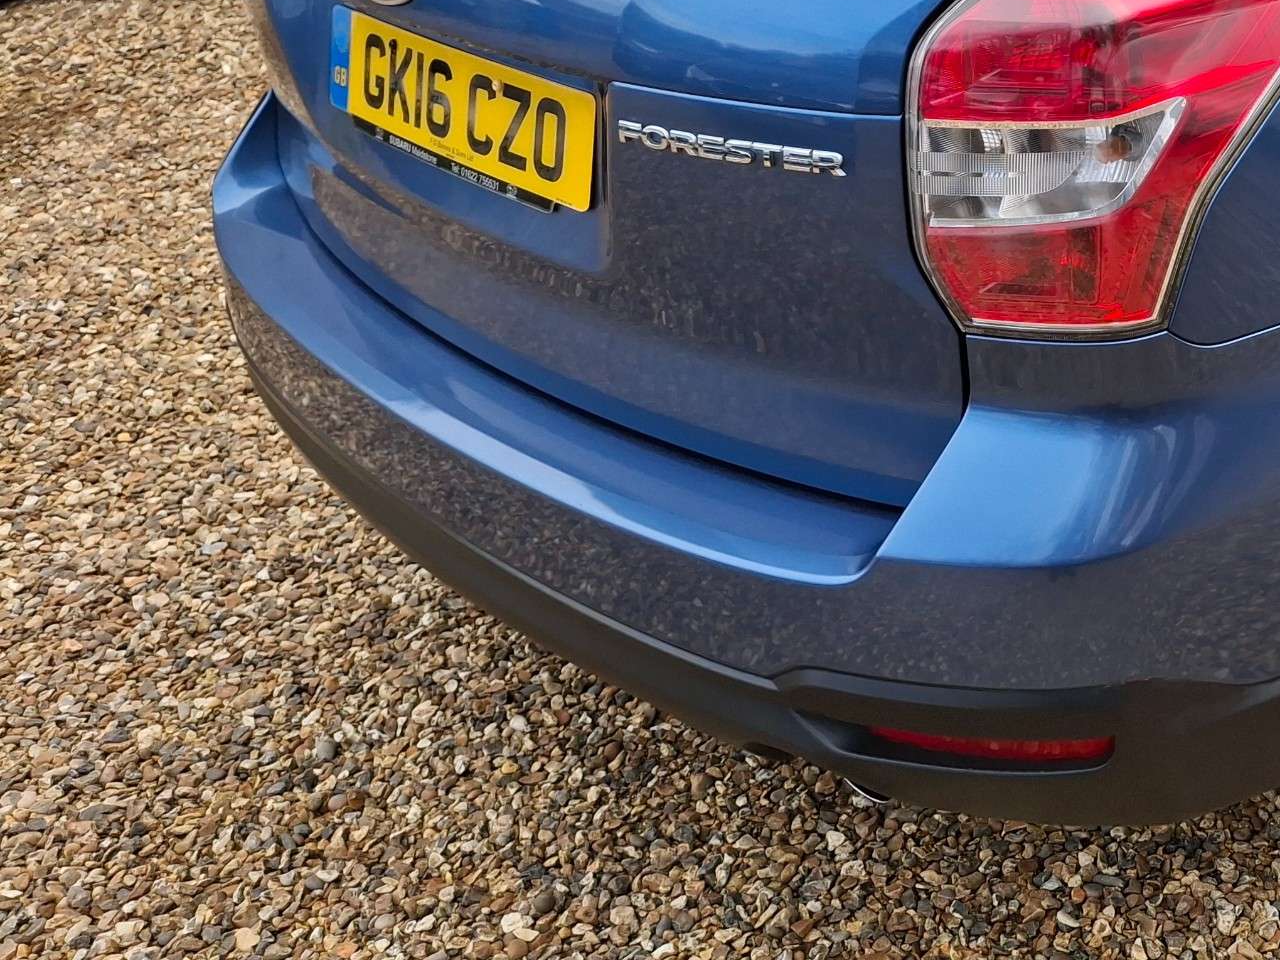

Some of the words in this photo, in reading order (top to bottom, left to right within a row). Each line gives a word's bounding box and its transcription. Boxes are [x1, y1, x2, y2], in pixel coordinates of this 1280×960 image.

[334, 65, 347, 87] GB
[363, 33, 453, 139] GK16
[466, 73, 567, 183] CZO
[389, 134, 412, 153] SUBARU
[617, 119, 848, 178] FORESTER
